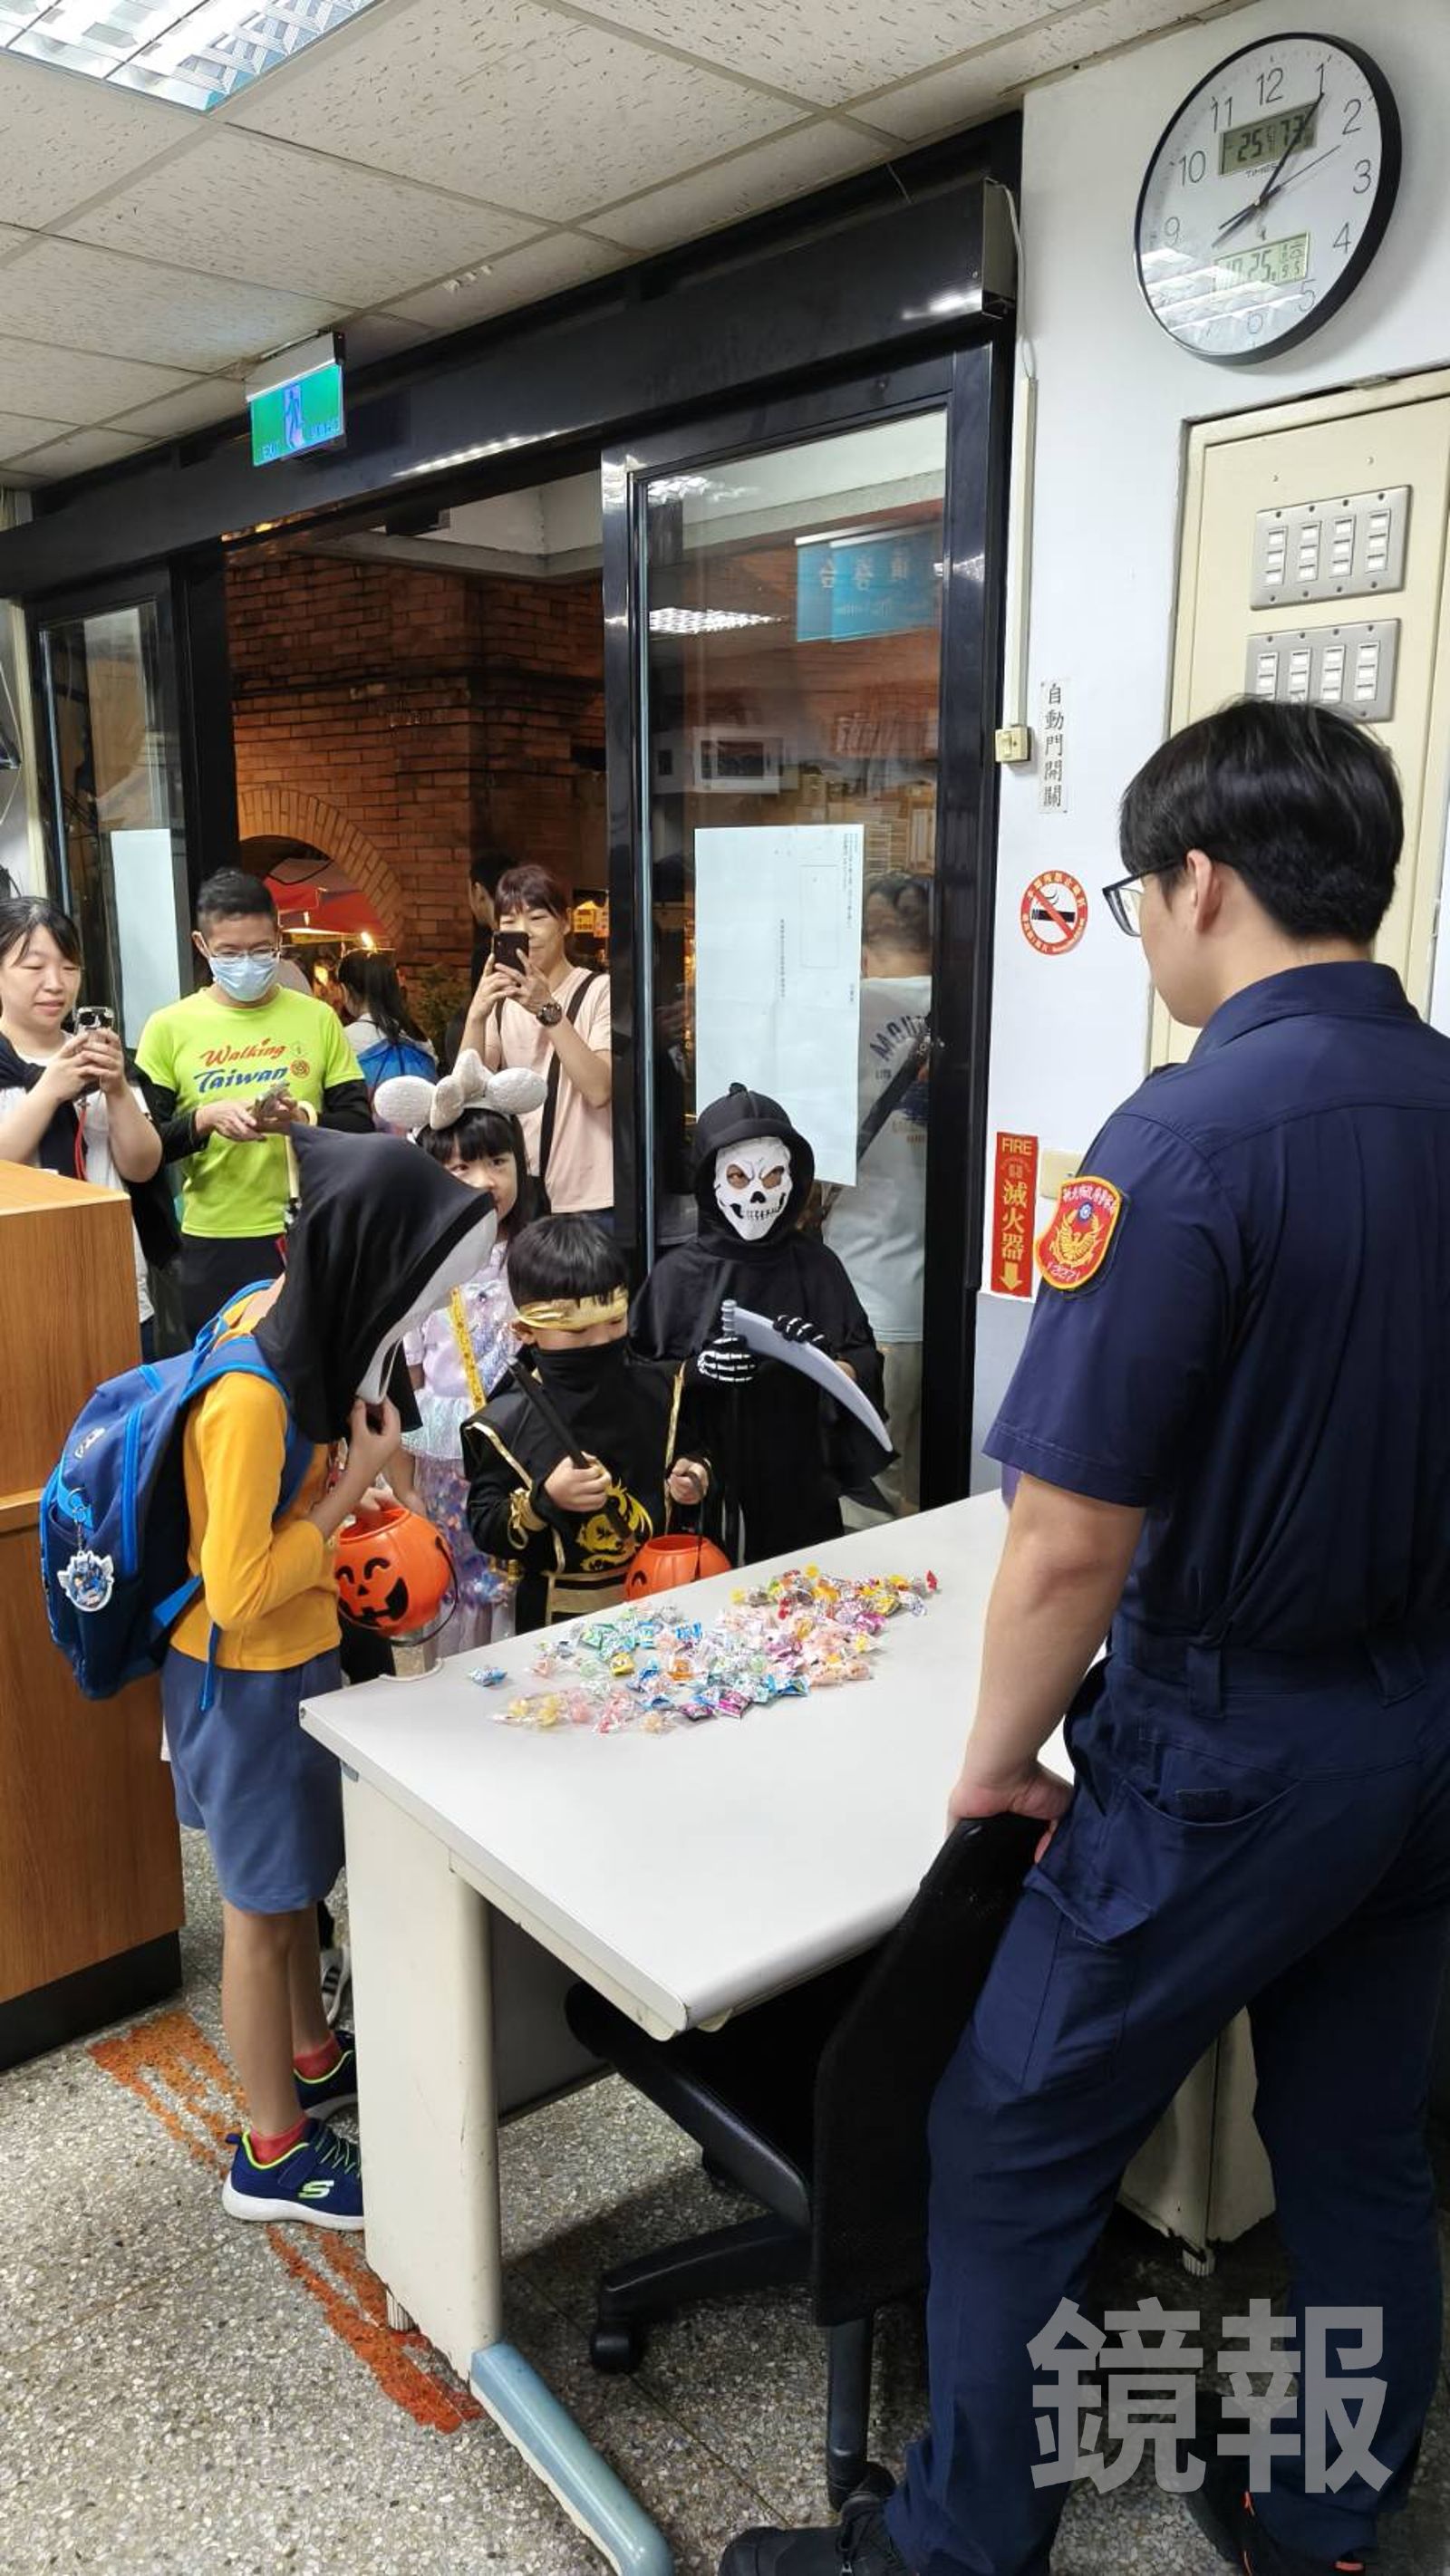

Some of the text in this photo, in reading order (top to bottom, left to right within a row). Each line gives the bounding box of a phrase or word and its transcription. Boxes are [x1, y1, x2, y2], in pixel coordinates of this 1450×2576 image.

[1256, 67, 1285, 107] 12
[1211, 95, 1233, 133] 11
[1342, 98, 1362, 135] 2
[1237, 127, 1263, 162] 25
[1177, 149, 1207, 187] 10
[1352, 159, 1372, 195] 3
[1164, 217, 1181, 249] 9
[1331, 221, 1351, 255] 4
[1298, 278, 1317, 313] 5
[1043, 682, 1065, 808] 自動門開關
[200, 1038, 288, 1067] Walking
[193, 1066, 289, 1094] Taiwan
[1001, 1136, 1033, 1156] FIRE
[1001, 1178, 1028, 1262] 滅火器
